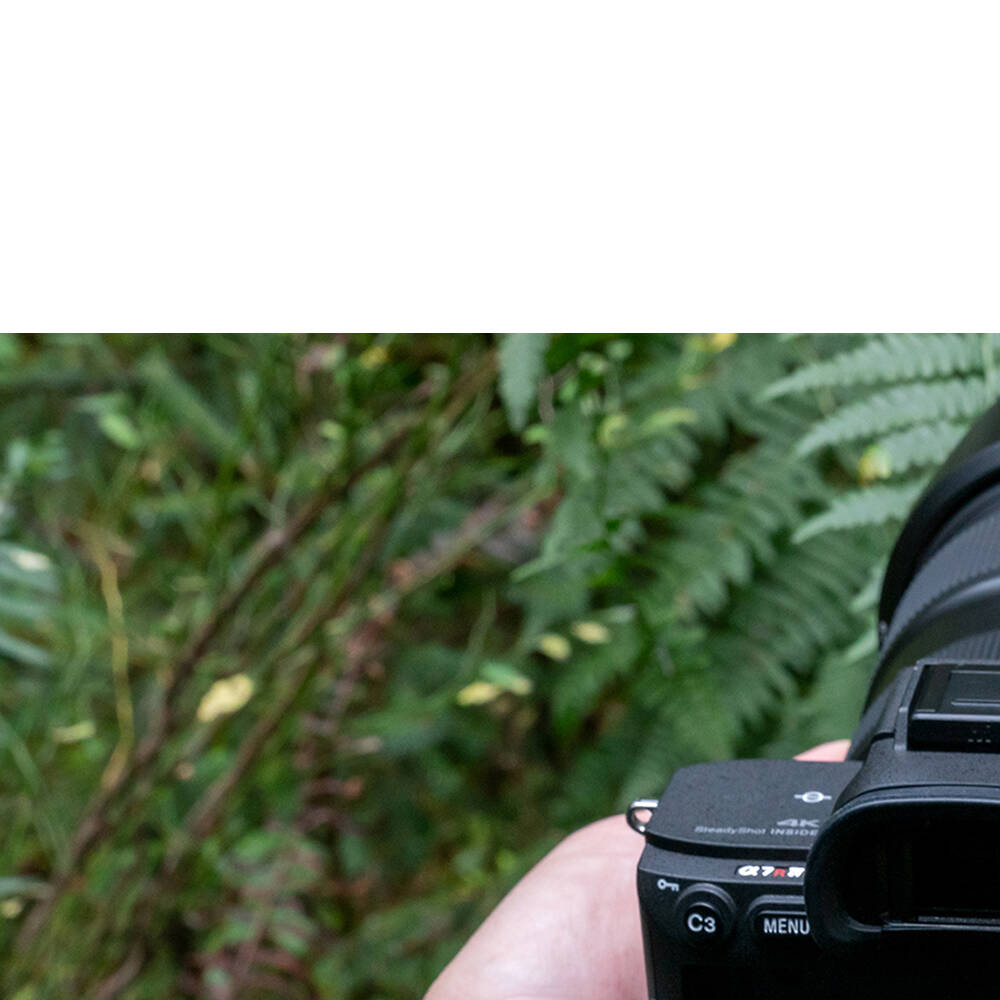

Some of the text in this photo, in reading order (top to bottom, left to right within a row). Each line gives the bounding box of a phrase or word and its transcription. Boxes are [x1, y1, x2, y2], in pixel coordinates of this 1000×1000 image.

[776, 818, 819, 828] 4K
[687, 913, 716, 933] C3
[763, 918, 811, 935] MENU
